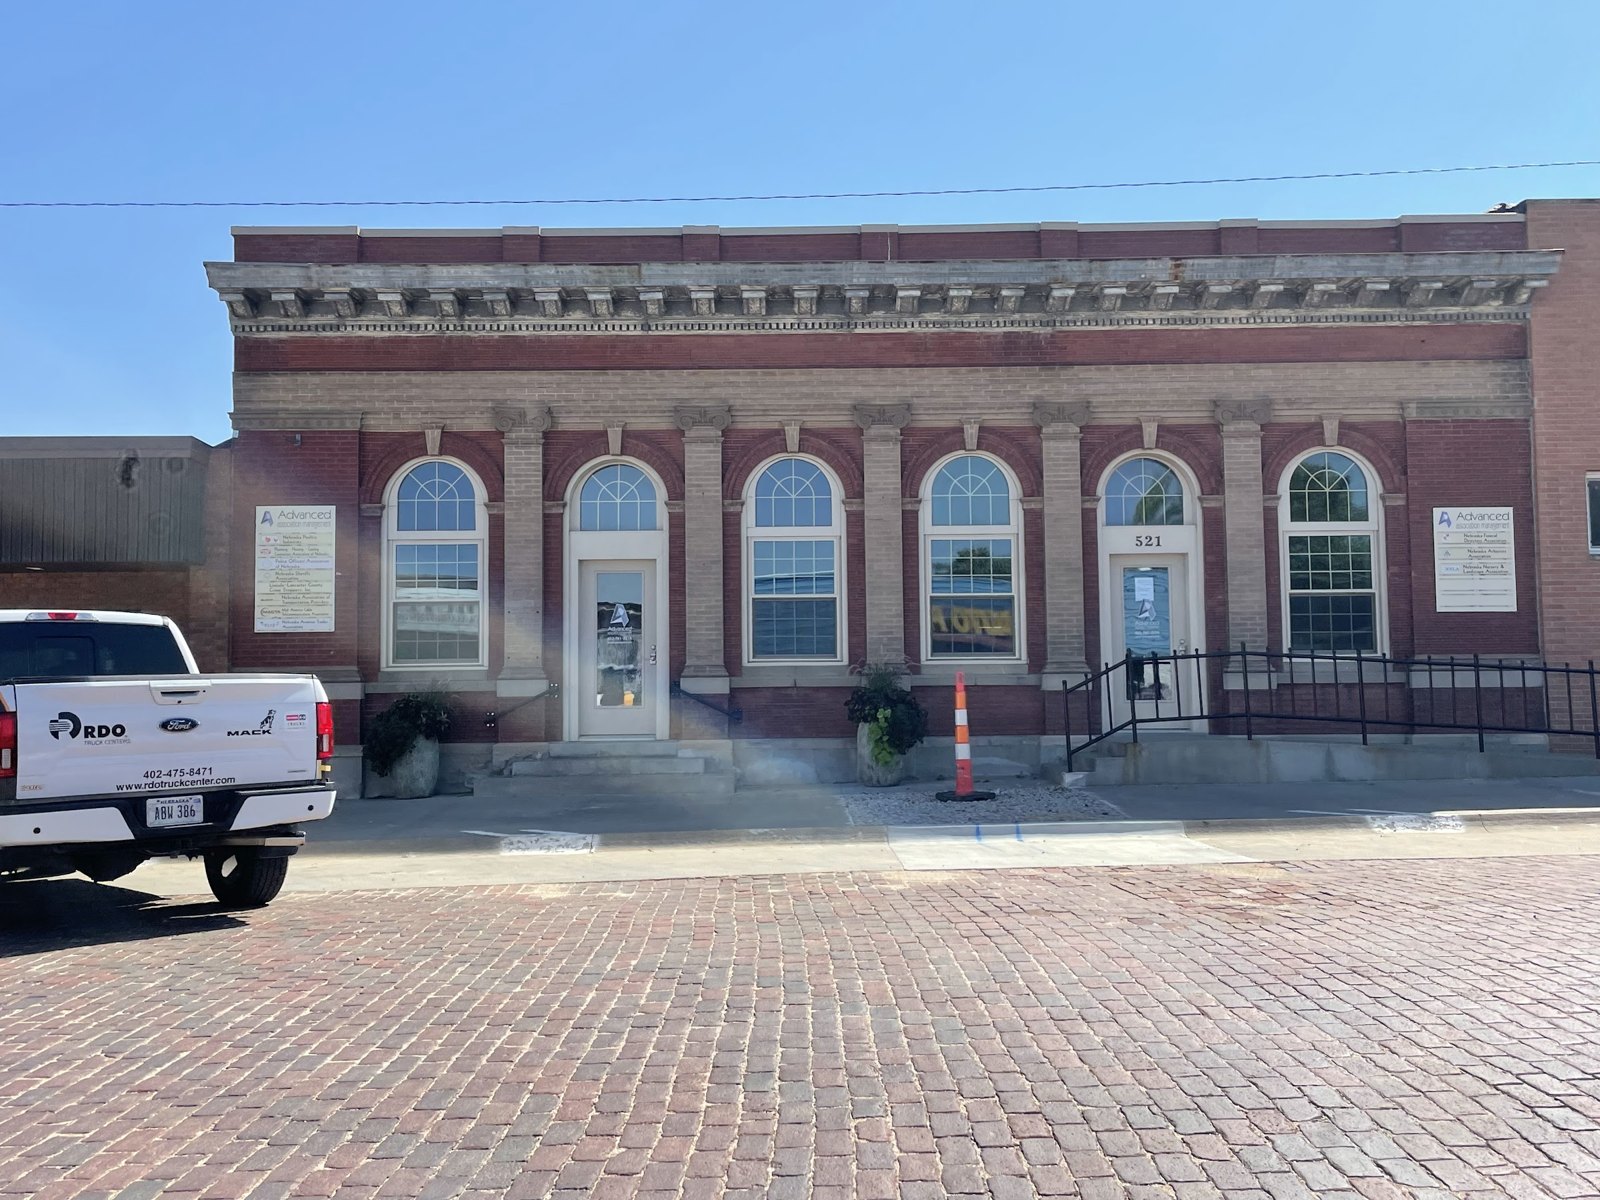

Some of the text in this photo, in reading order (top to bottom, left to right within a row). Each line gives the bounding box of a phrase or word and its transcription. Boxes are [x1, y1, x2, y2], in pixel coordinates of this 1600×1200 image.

[278, 510, 332, 520] Advanced
[1456, 512, 1510, 521] Advanced
[1135, 535, 1163, 547] 521
[84, 724, 126, 739] RDO
[167, 720, 191, 731] Ford
[143, 767, 213, 779] 402-475-8471
[116, 777, 236, 791] www.rdotruckcenter.com
[154, 804, 196, 820] ABW 386
